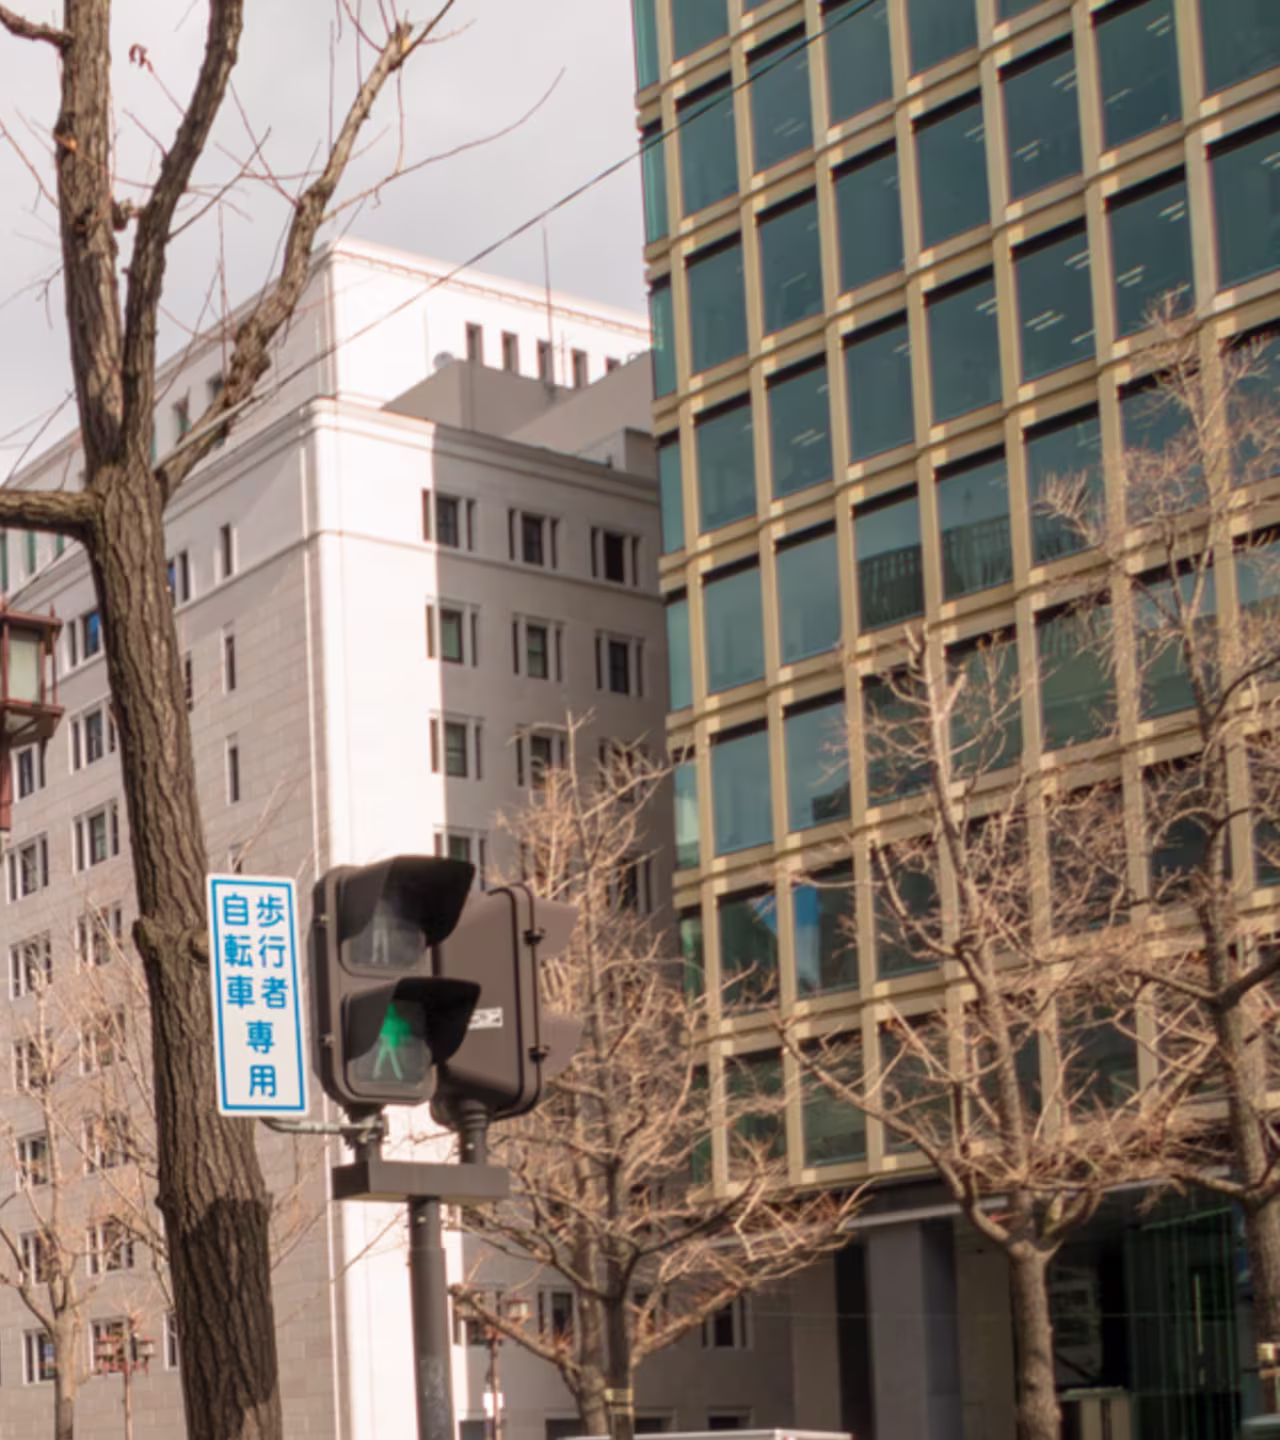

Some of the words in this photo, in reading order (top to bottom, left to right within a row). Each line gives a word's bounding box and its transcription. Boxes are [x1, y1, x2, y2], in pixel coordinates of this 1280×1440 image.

[223, 892, 255, 1008] 自転車
[255, 893, 288, 1009] 歩行者
[245, 1020, 276, 1098] 専用
